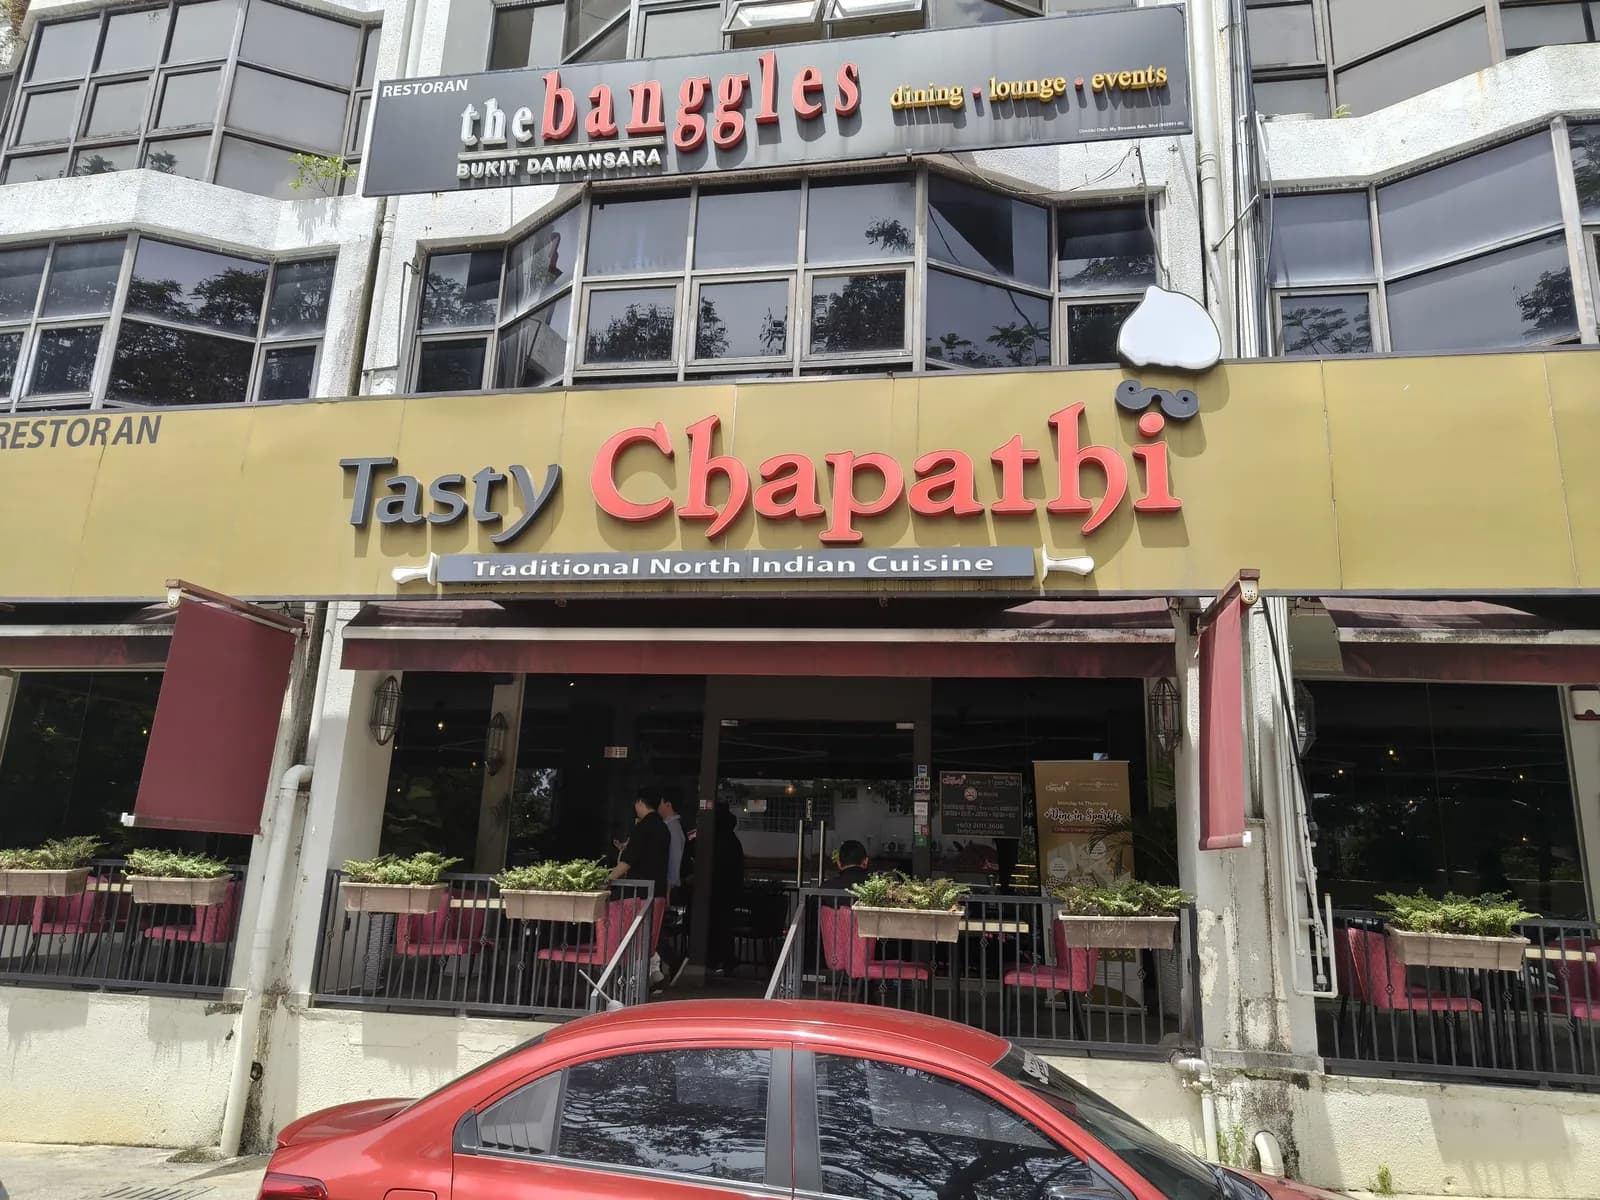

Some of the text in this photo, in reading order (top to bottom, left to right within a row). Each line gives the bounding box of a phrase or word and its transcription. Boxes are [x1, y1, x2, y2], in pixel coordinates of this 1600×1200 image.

[382, 79, 469, 97] RESTORAN
[460, 50, 858, 152] the banggles
[890, 65, 1168, 110] dining lounge events
[456, 148, 662, 179] BUKIT DAMANSARA
[339, 401, 1184, 545] Tasty Chapathi
[473, 554, 994, 577] Traditional North Indian Cuisine
